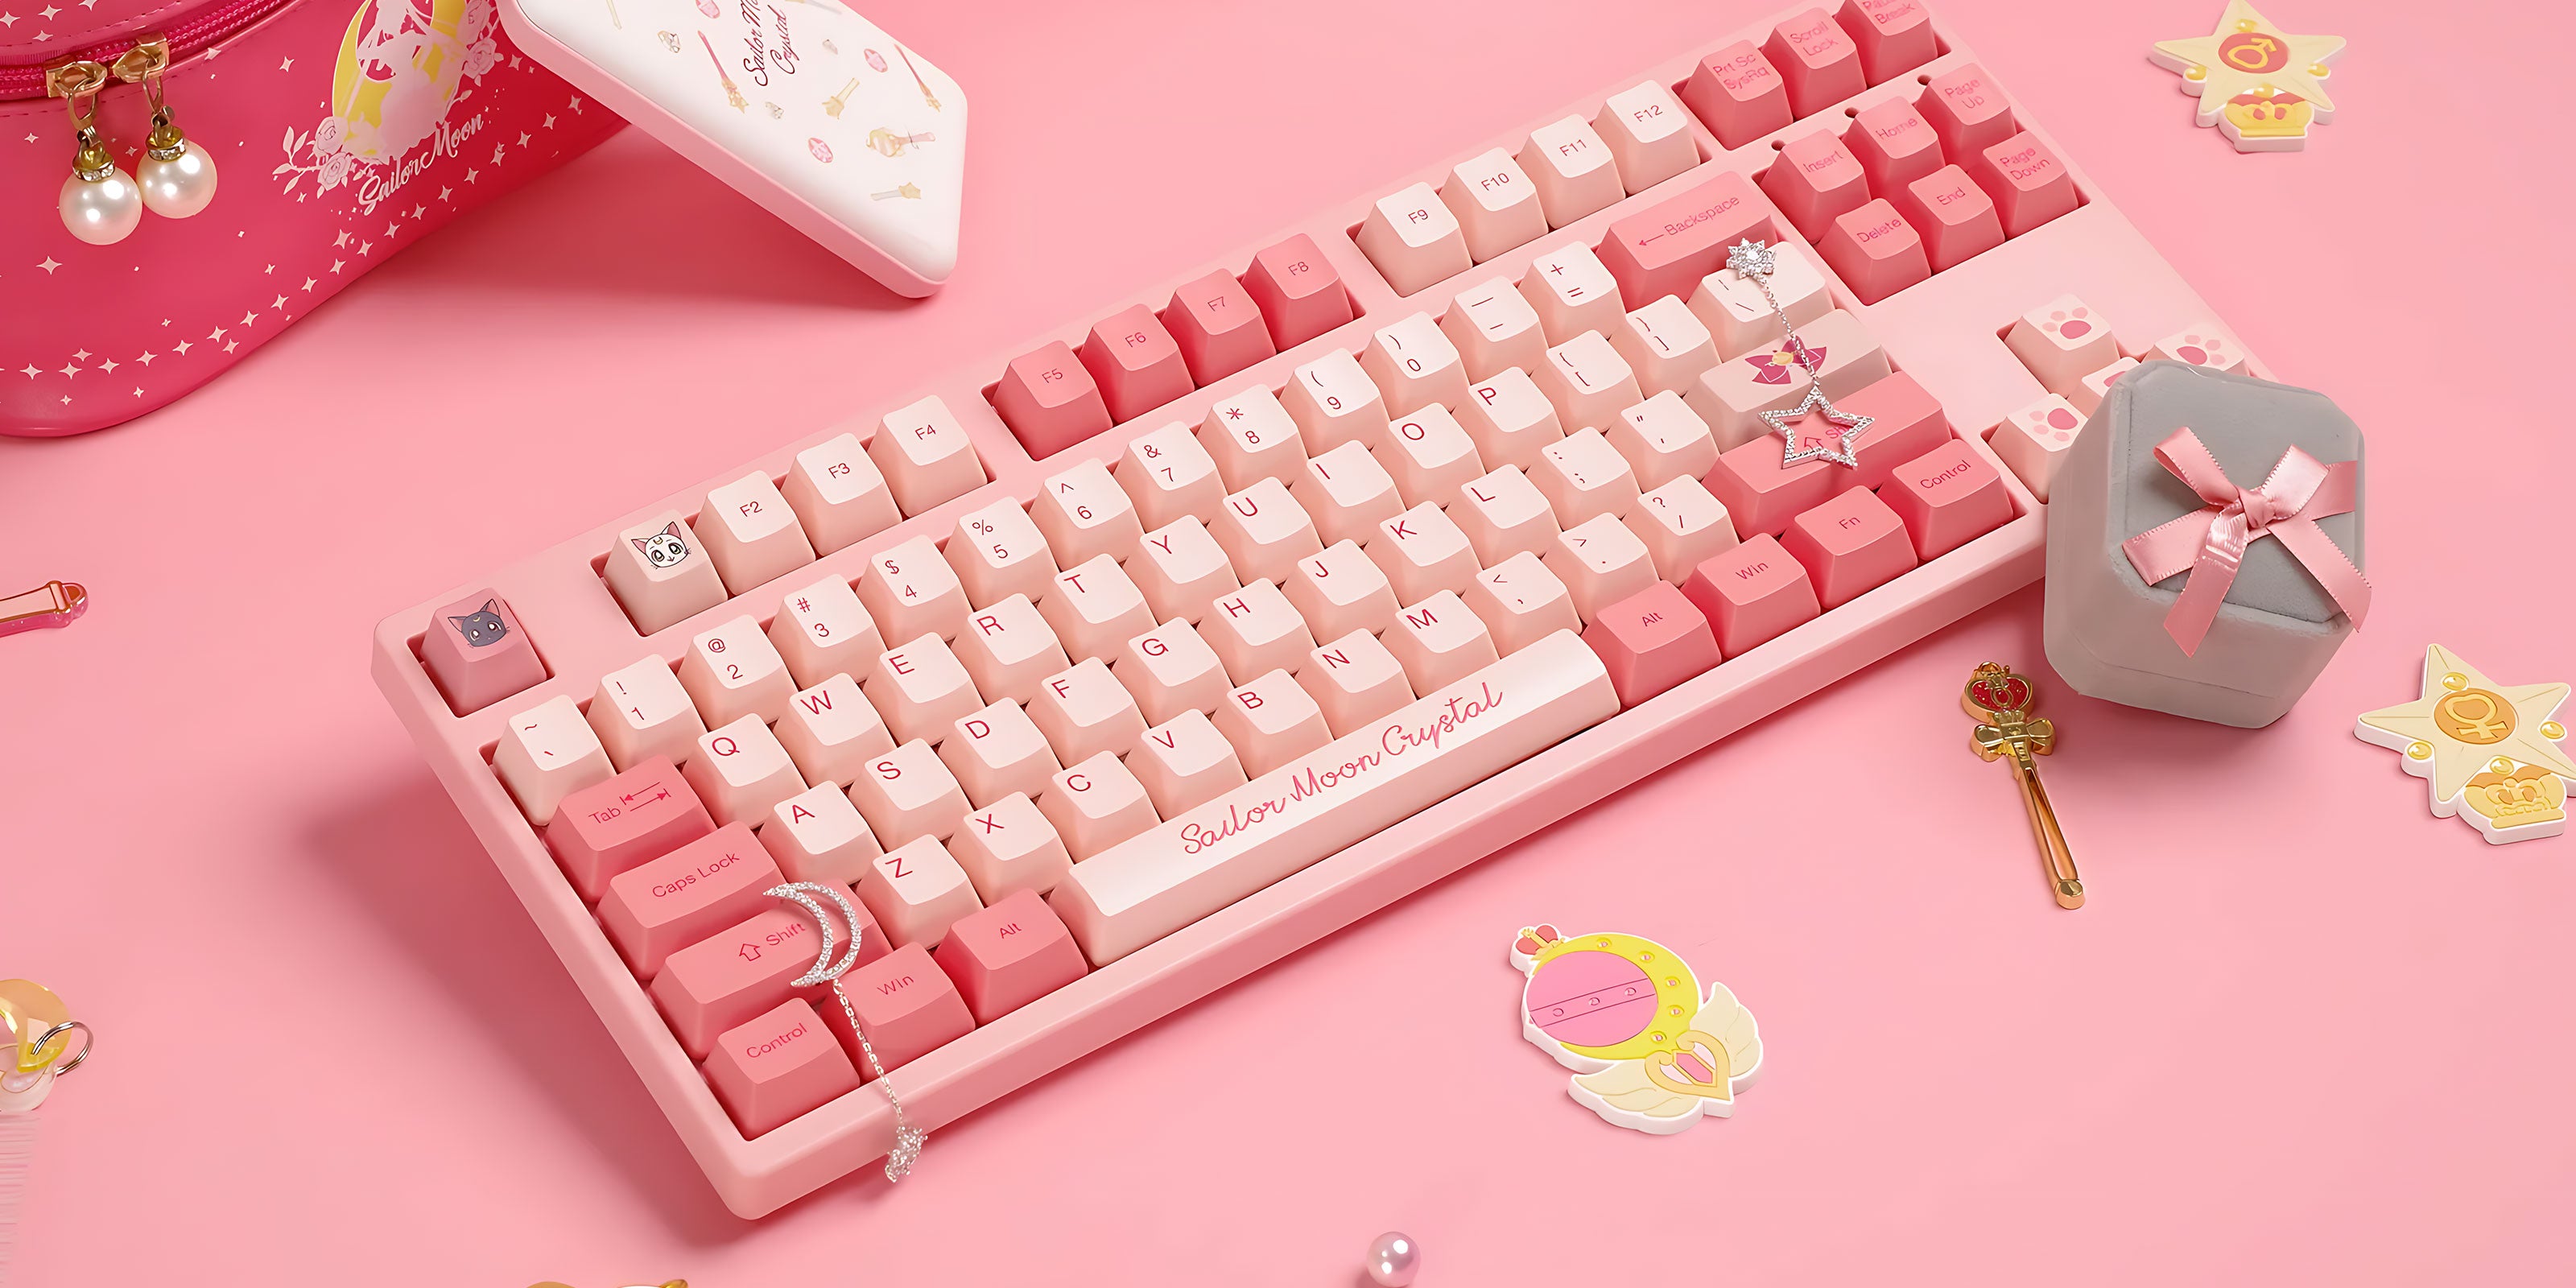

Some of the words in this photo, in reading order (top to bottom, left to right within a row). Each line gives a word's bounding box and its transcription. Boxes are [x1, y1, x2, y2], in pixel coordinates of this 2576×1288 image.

[770, 5, 799, 74] Crystal
[1790, 21, 1829, 43] Scroll
[1802, 39, 1839, 56] Lock
[743, 29, 768, 86] Sailor
[1712, 63, 1736, 76] Prt
[1736, 54, 1757, 68] Sc
[1724, 67, 1770, 89] SysRq
[1944, 79, 1980, 97] Page
[1961, 96, 1985, 109] Up
[1634, 104, 1663, 122] F12
[1875, 118, 1918, 141] Home
[1559, 138, 1587, 156] F11
[359, 157, 420, 216] Sailor
[419, 114, 484, 169] Moon
[1803, 151, 1843, 173] Insert
[2000, 147, 2036, 167] Page
[2010, 159, 2050, 180] Down
[1481, 173, 1509, 191] F10
[1936, 187, 1966, 205] End
[1408, 209, 1429, 224] F9
[1664, 196, 1740, 236] Backspace
[1856, 218, 1902, 243] Delete
[1288, 261, 1309, 275] F8
[1208, 297, 1226, 312] F7
[1125, 332, 1146, 348] F6
[1406, 358, 1421, 371] 0
[1042, 368, 1063, 384] F5
[1327, 397, 1342, 410] 9
[1478, 387, 1496, 406] P
[915, 424, 936, 440] F4
[1245, 431, 1260, 444] 8
[1402, 423, 1425, 440] O
[1144, 445, 1162, 458] &
[828, 463, 850, 479] F3
[1161, 468, 1174, 482] 7
[1315, 463, 1331, 480] I
[1920, 460, 1971, 490] Control
[1471, 487, 1496, 502] L
[740, 501, 762, 517] F2
[1077, 506, 1092, 519] 6
[1232, 497, 1259, 517] U
[972, 519, 993, 536] %
[1389, 520, 1418, 540] K
[1839, 515, 1861, 530] Fn
[993, 544, 1009, 559] 5
[1150, 535, 1172, 555] Y
[885, 559, 899, 574] $
[1315, 560, 1329, 578] J
[1735, 562, 1769, 581] Win
[905, 584, 917, 599] 4
[1063, 574, 1085, 593] T
[797, 597, 810, 612] #
[1223, 597, 1250, 617] H
[976, 615, 1005, 636] R
[1406, 609, 1439, 630] M
[1641, 612, 1663, 627] Alt
[814, 623, 830, 638] 3
[708, 638, 725, 653] @
[1141, 638, 1169, 656] G
[889, 654, 914, 675] E
[1322, 650, 1351, 668] N
[727, 664, 744, 680] 2
[1051, 679, 1070, 699] F
[800, 690, 833, 716] W
[1237, 691, 1264, 709] B
[631, 707, 645, 720] 1
[964, 720, 990, 740] D
[712, 737, 740, 757] Q
[1152, 730, 1175, 749] V
[877, 762, 901, 780] S
[1180, 796, 1287, 855] Sailor
[1290, 750, 1381, 802] Moon
[1381, 681, 1504, 755] Crystal
[1067, 774, 1092, 792] C
[588, 806, 621, 825] Tab
[792, 804, 815, 824] A
[975, 814, 1005, 834] X
[652, 873, 696, 898] Caps
[697, 851, 740, 877] Lock
[885, 857, 913, 878] Z
[766, 923, 805, 946] Shift
[1000, 923, 1022, 939] Alt
[877, 974, 914, 997] Win
[746, 1023, 808, 1059] Control
